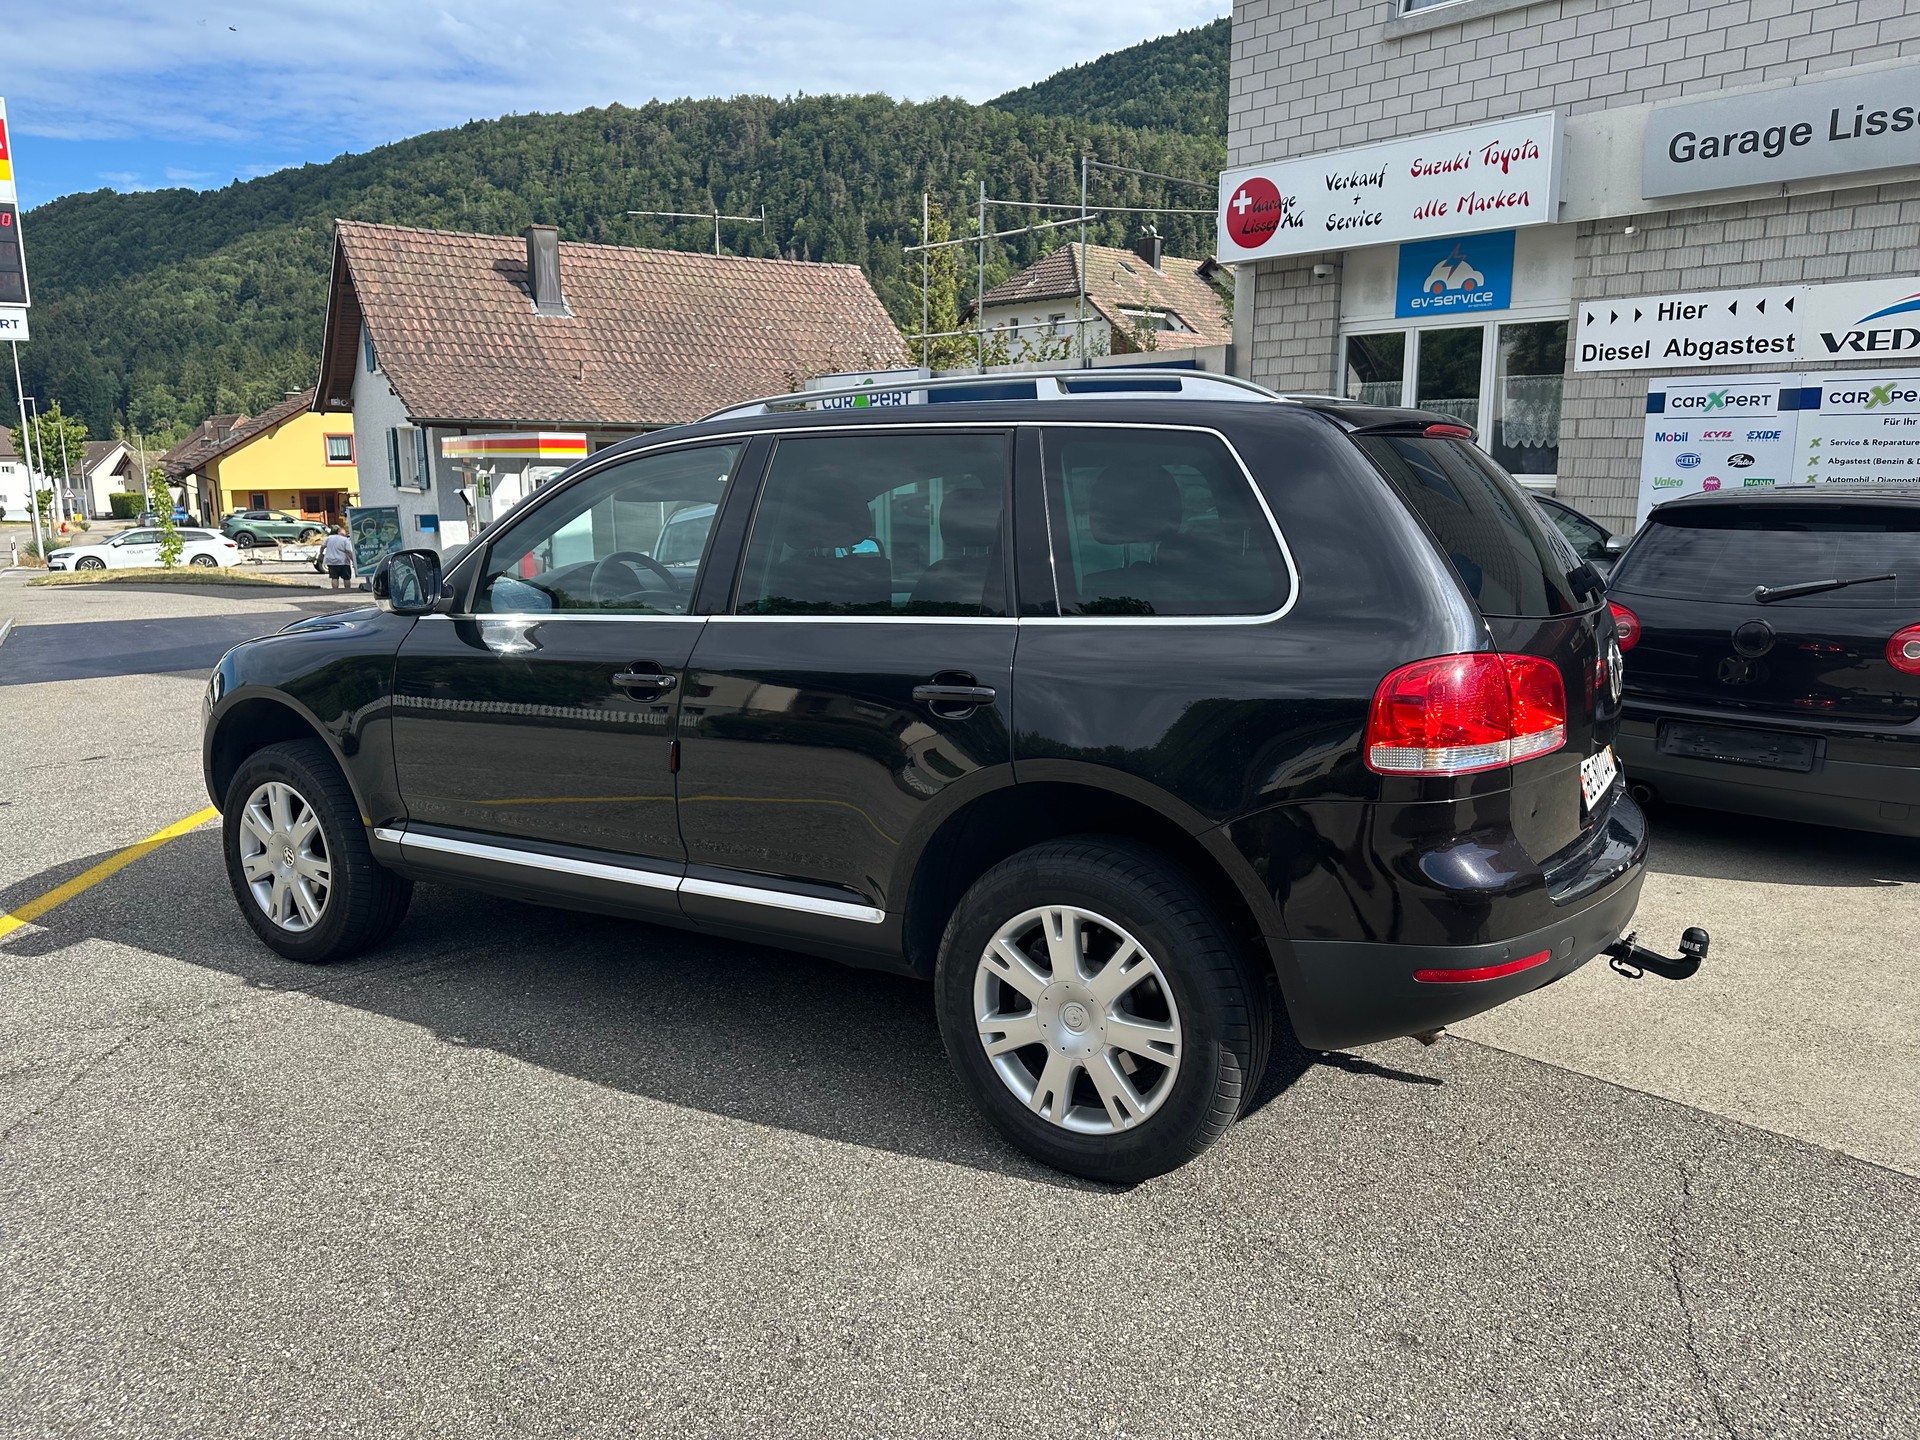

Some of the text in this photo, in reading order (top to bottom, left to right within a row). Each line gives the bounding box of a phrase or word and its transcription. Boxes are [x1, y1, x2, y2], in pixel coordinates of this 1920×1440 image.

[1668, 104, 1920, 163] Garage Liss
[1410, 138, 1539, 178] Suzuki Toyota
[1325, 162, 1388, 191] Verkauf
[1251, 193, 1296, 213] Garage
[1413, 189, 1530, 220] alle Marken
[1241, 212, 1280, 235] Lisser
[1325, 210, 1383, 232] Service
[1411, 291, 1494, 308] ev-service
[1657, 301, 1708, 322] Hier
[1581, 333, 1796, 362] Diesel Abgastest
[1819, 328, 1920, 354] VRED
[1883, 417, 1918, 426] Für Ihr
[1655, 431, 1689, 442] Mobil
[1703, 430, 1733, 438] KYB
[1746, 430, 1782, 440] EXIDE
[1830, 438, 1861, 446] Service
[1862, 438, 1870, 446] &
[1676, 456, 1701, 465] HELLA
[1828, 457, 1871, 467] Abgastest
[1872, 457, 1905, 466] (Benzin
[1906, 457, 1914, 465] &
[1654, 476, 1684, 487] Valeo
[1825, 475, 1870, 483] Automobil
